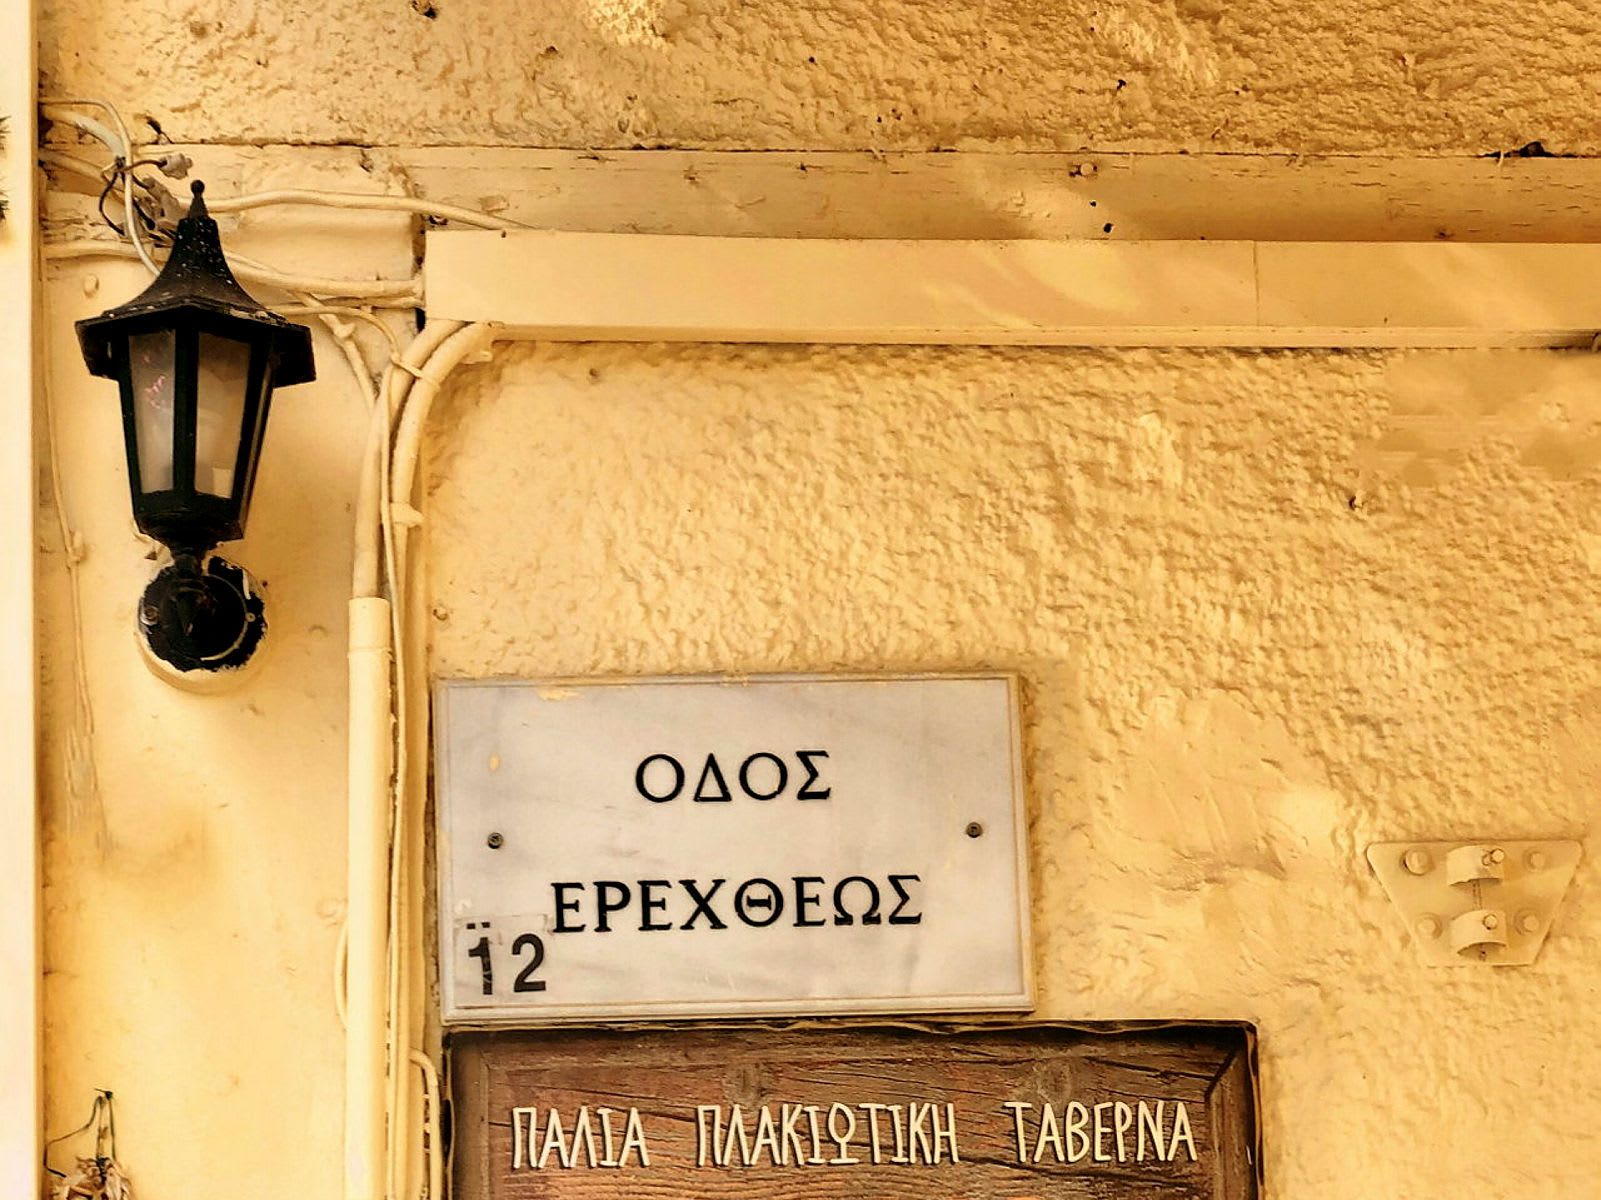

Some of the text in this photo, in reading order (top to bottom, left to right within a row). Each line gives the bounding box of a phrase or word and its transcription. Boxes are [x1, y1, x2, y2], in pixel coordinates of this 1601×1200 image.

[635, 750, 832, 802] ΟΔΟΣ
[551, 874, 922, 934] ΕΡΕΧΘΕΩΣ
[467, 932, 547, 996] 12
[511, 1099, 1198, 1169] ΠΑΛΙΑ ΠΛΑΚΙΩΤΙΚΗ ΤΑΒΕΡΝΑ
